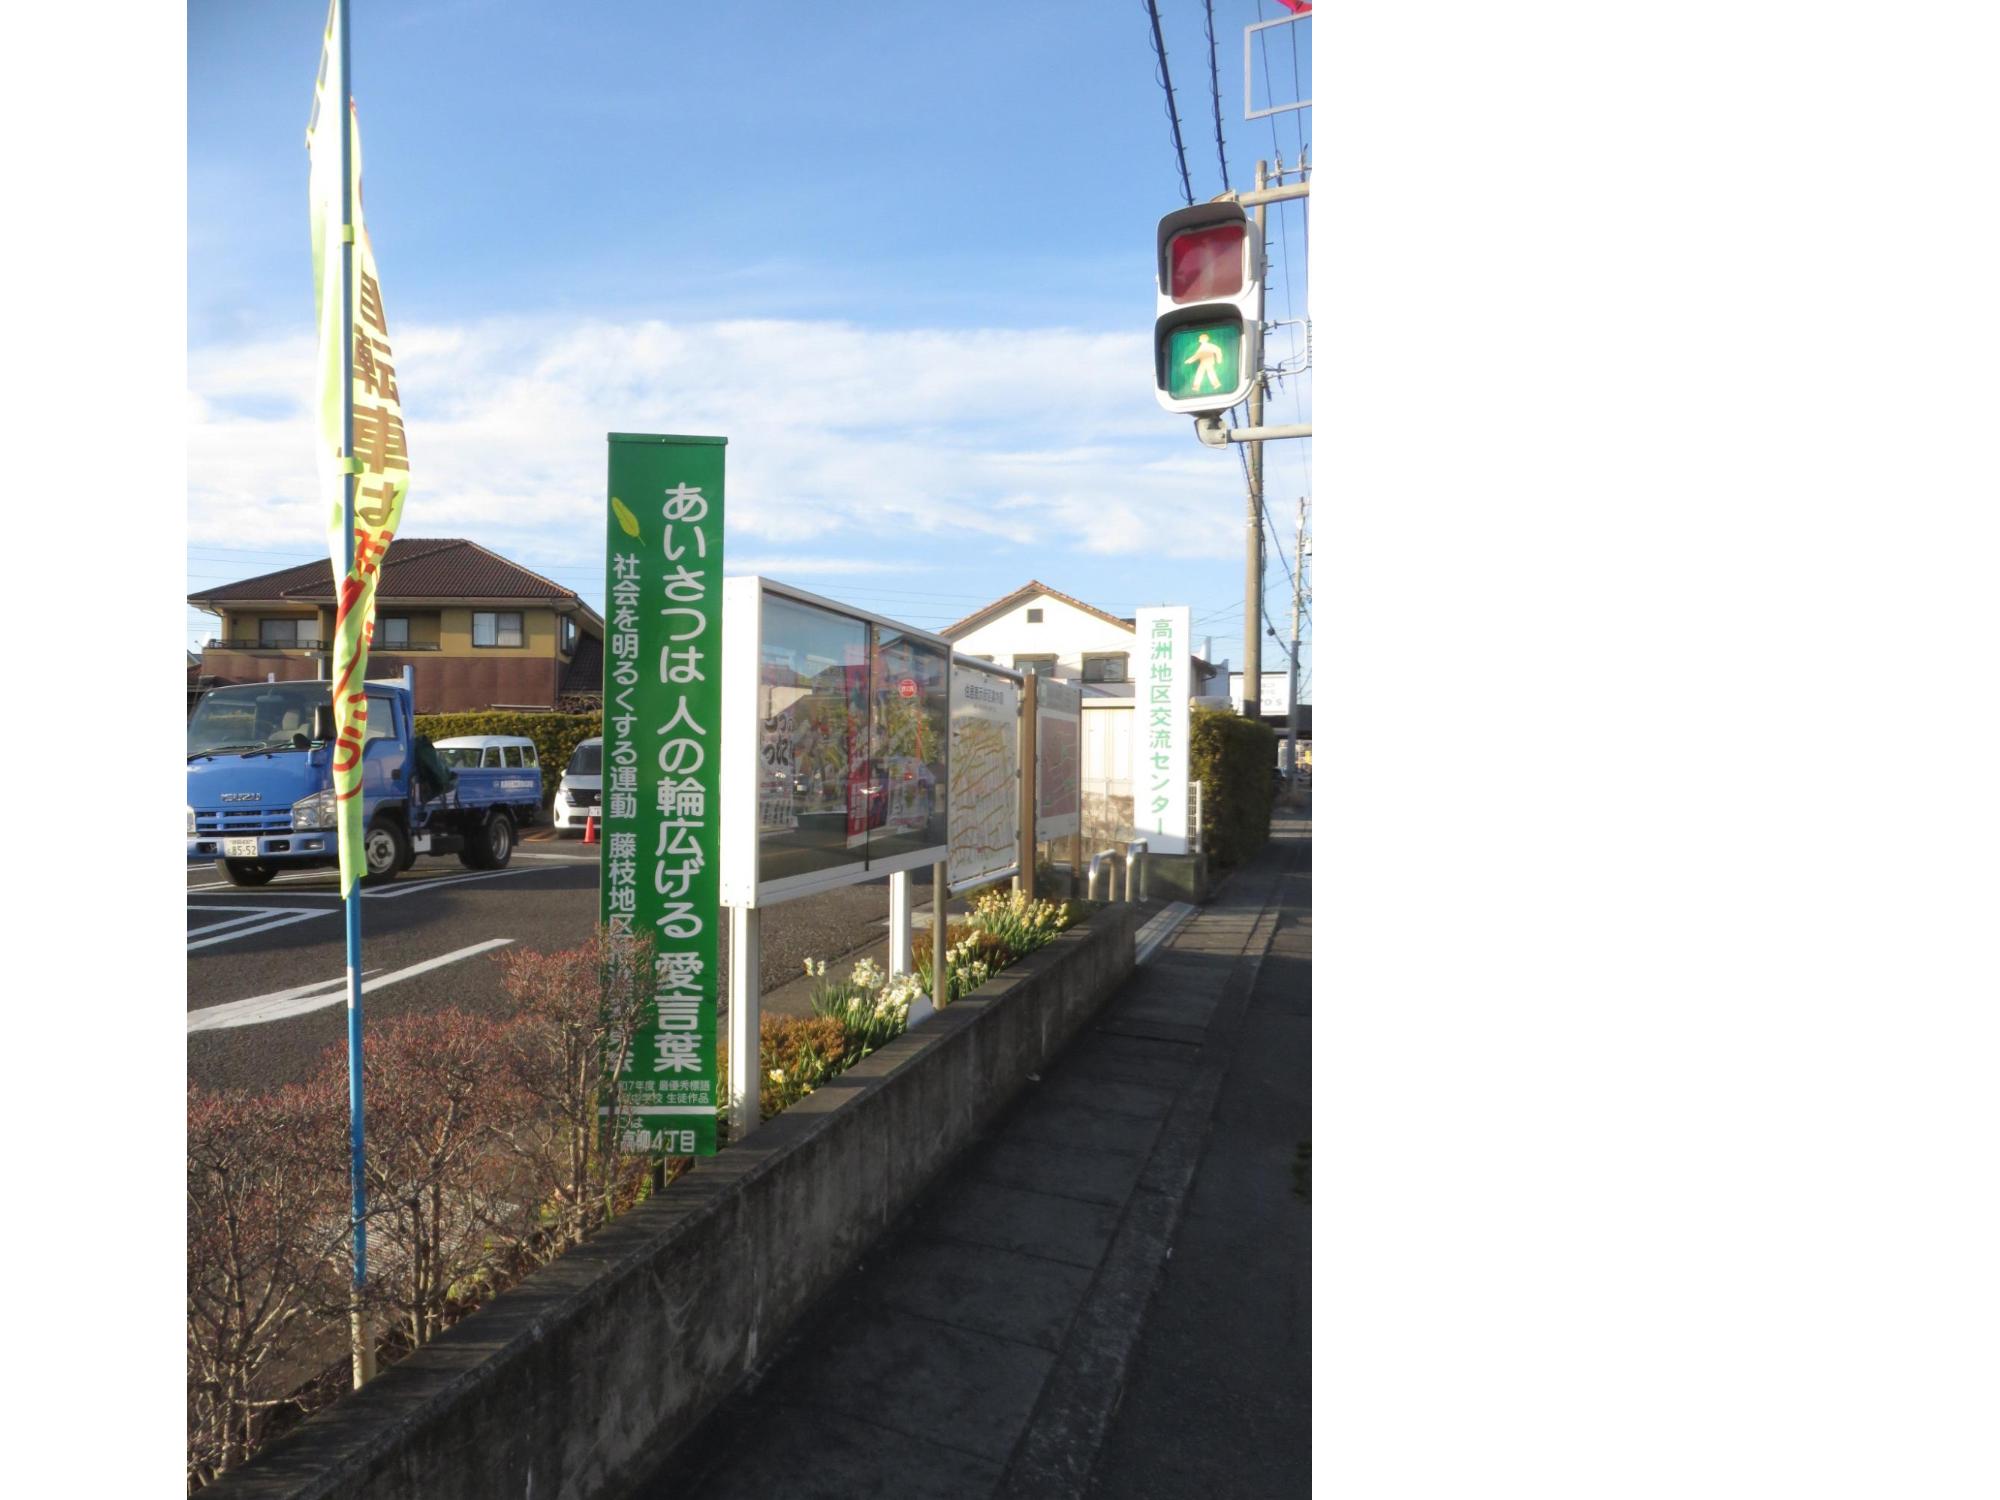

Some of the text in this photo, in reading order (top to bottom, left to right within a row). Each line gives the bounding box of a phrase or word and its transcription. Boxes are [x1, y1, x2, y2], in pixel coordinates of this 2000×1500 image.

[609, 553, 641, 819] 社会を明るくする運動
[653, 482, 708, 1073] あいさつは 人の輪広げる 愛言葉
[1149, 618, 1173, 836] 高洲地区交流センター
[666, 1092, 710, 1105] 生徒作品
